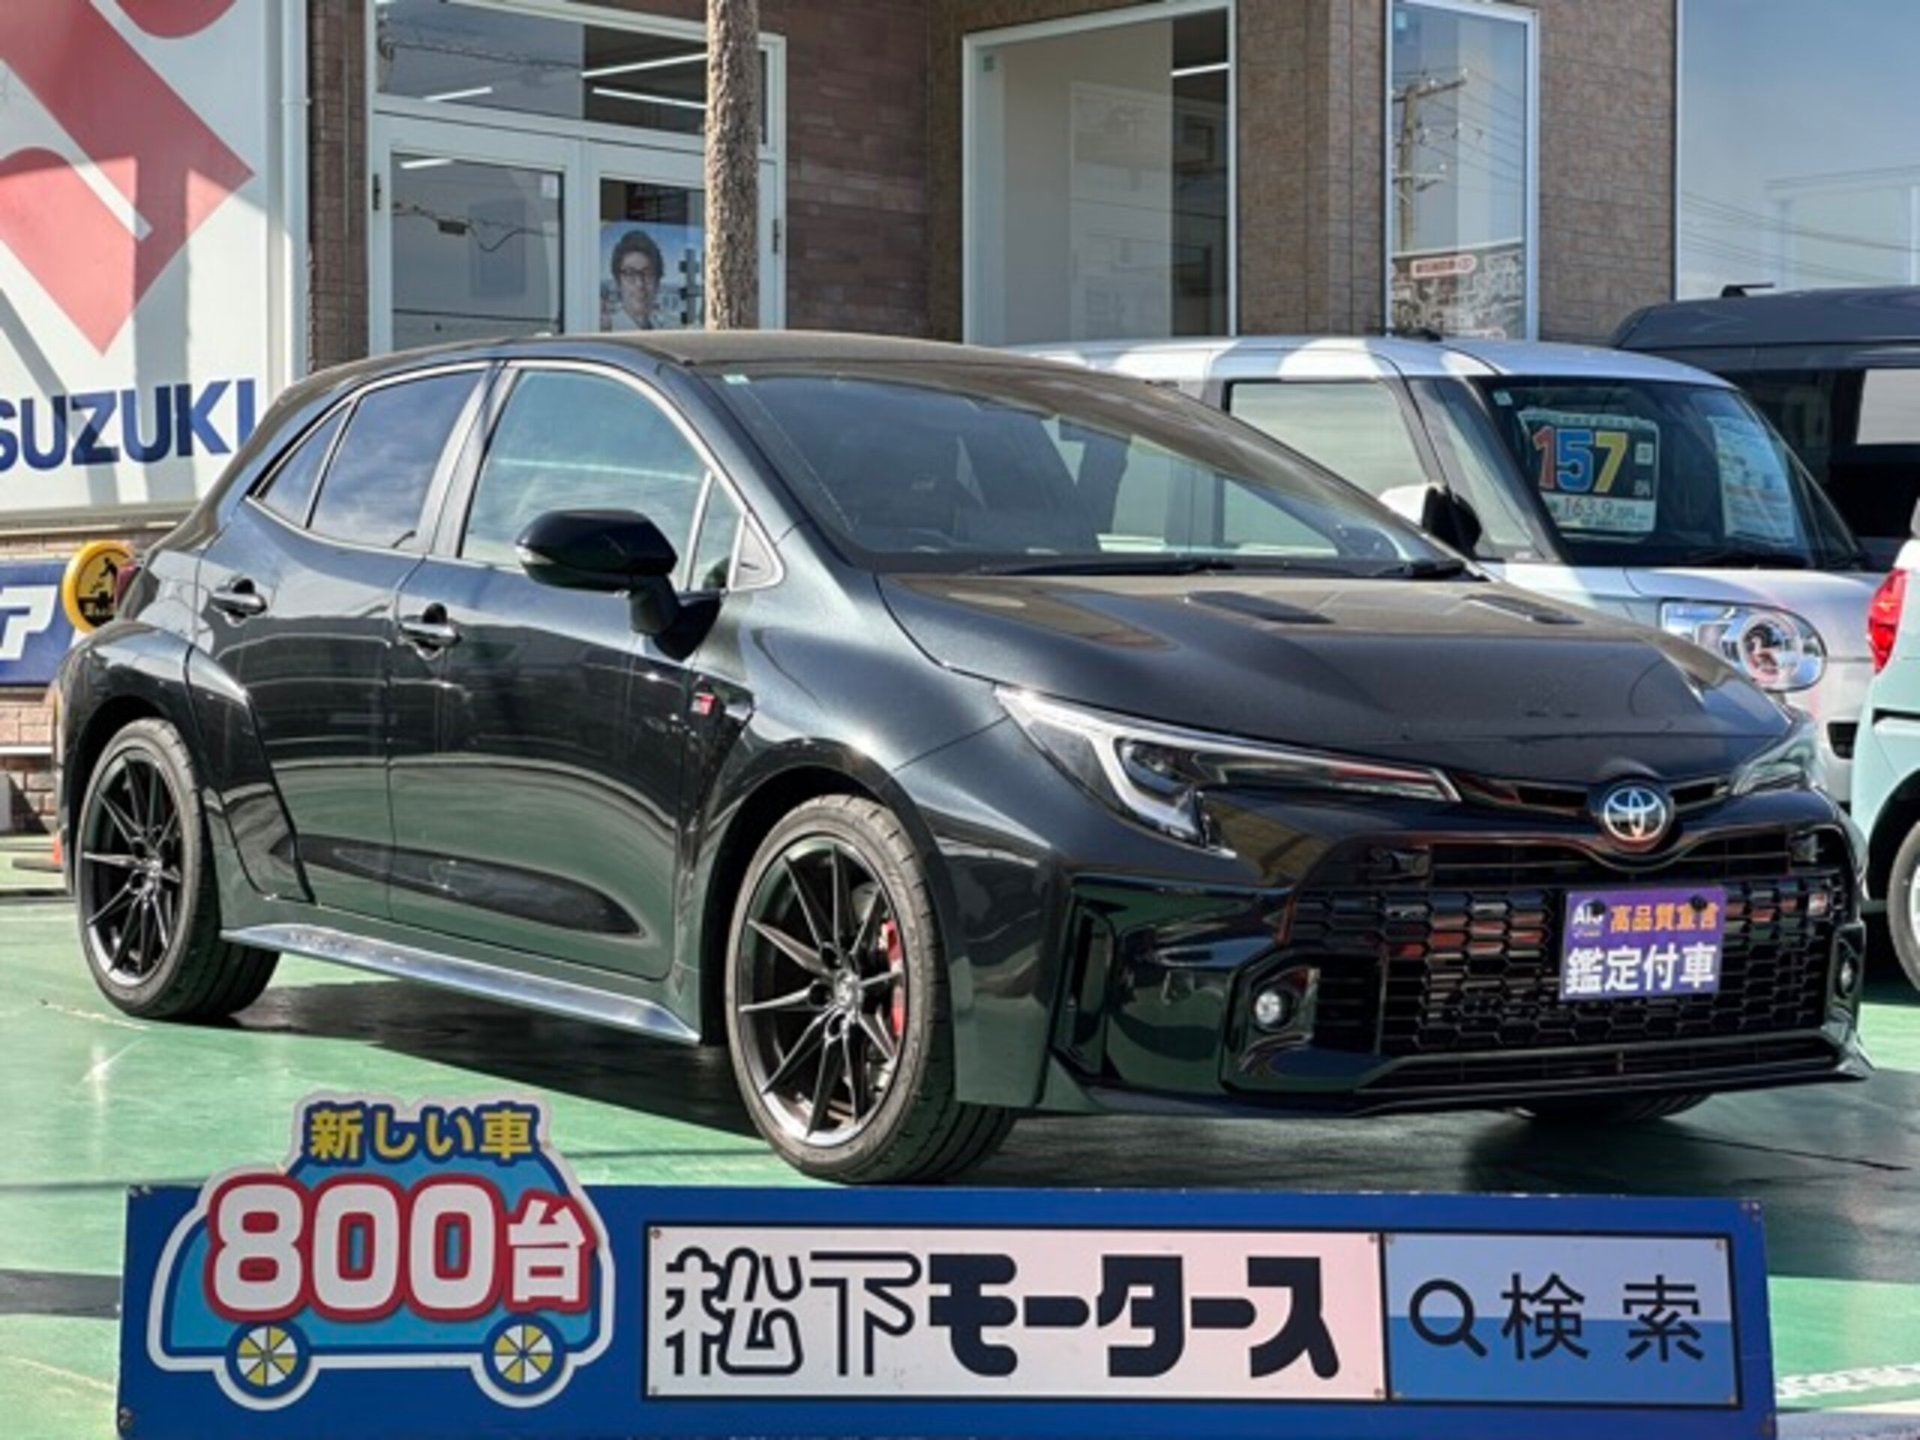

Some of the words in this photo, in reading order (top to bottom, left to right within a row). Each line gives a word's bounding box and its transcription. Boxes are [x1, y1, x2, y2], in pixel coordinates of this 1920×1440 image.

[1532, 426, 1628, 493] 157
[1565, 942, 1717, 994] 鑑定付車
[309, 1107, 533, 1161] 新しい車
[213, 1182, 586, 1312] 800台
[665, 1247, 1341, 1380] 松下モータース
[1500, 1273, 1706, 1362] 検索
